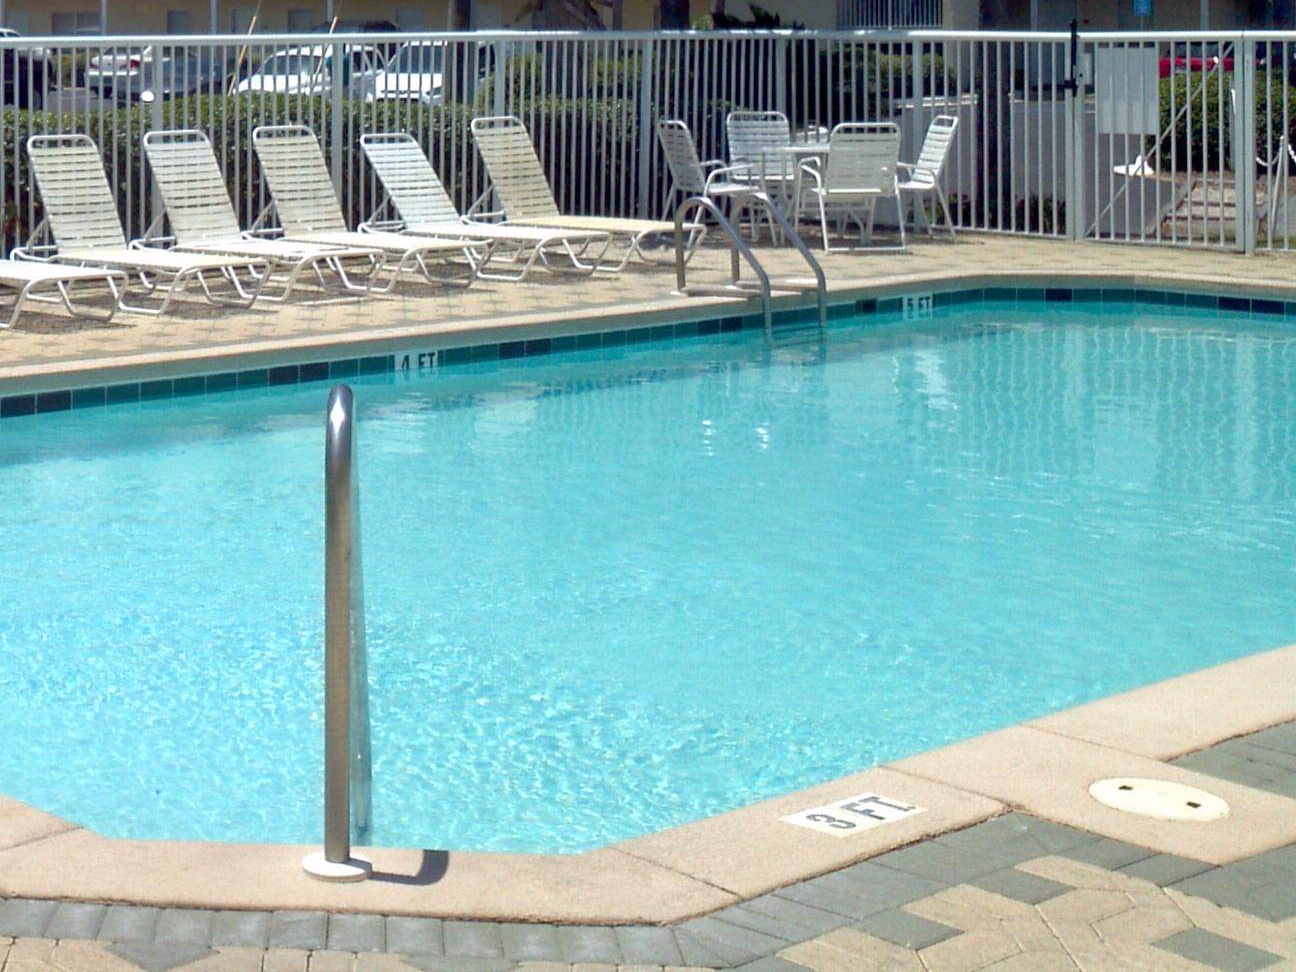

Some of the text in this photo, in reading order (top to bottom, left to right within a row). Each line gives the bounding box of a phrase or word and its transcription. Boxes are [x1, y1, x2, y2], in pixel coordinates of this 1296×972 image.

[401, 352, 436, 372] 4 FT
[805, 813, 857, 830] 3
